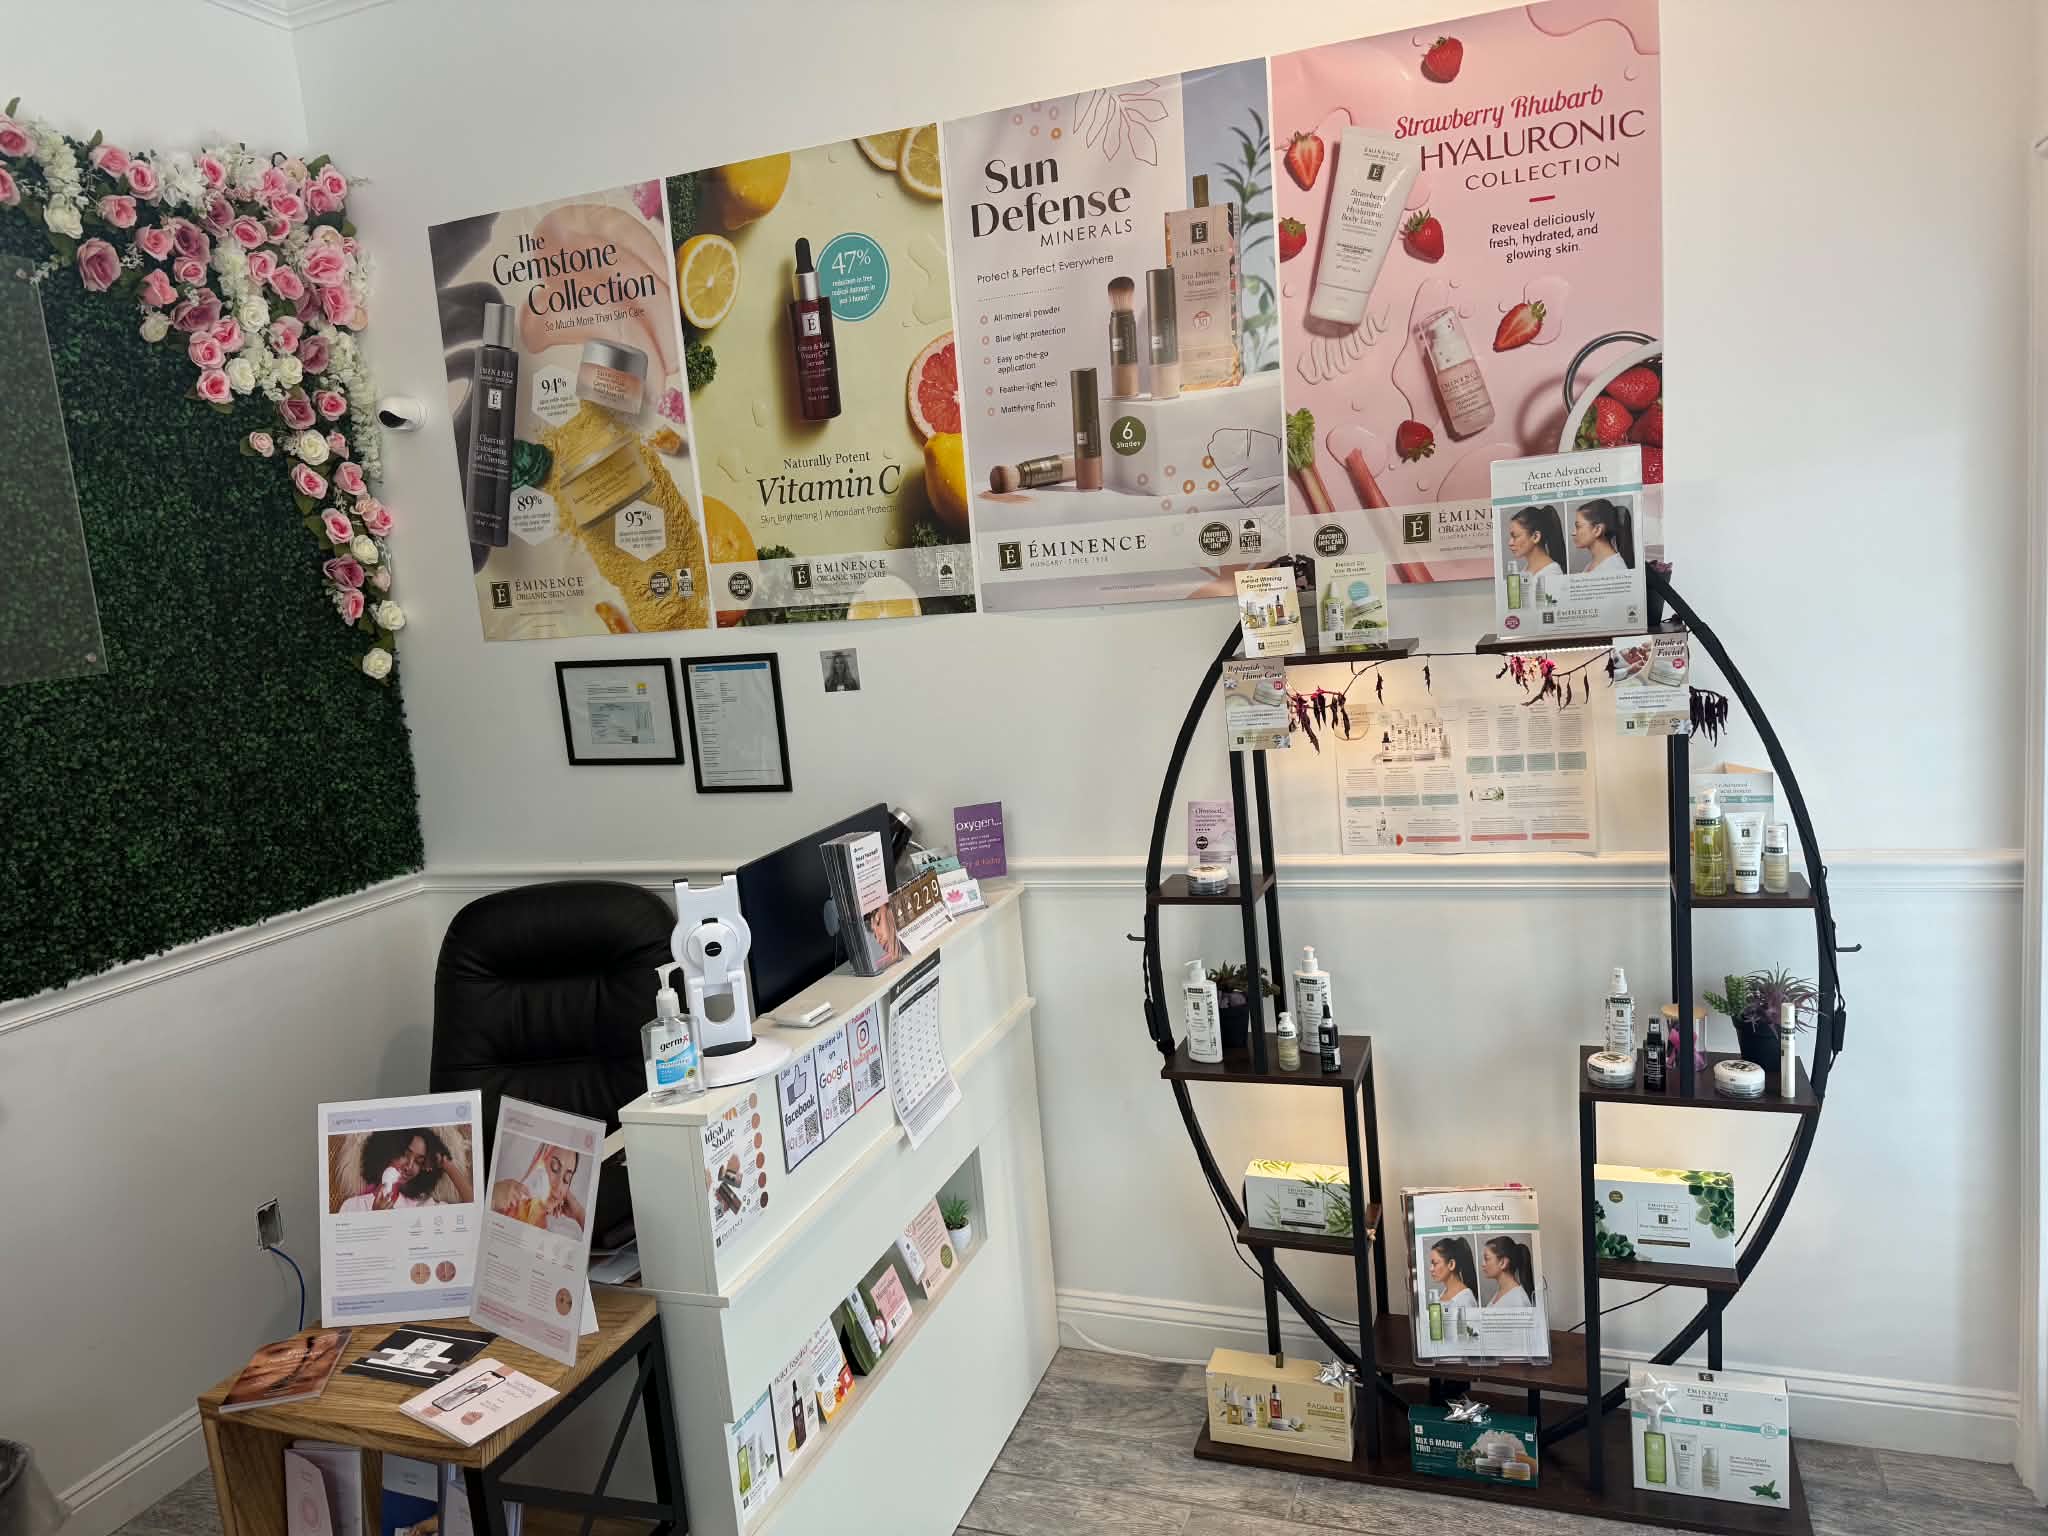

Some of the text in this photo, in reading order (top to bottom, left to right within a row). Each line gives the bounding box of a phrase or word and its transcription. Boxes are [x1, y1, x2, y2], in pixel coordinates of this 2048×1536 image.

[1394, 84, 1603, 139] Strawberry Rhubarb
[1421, 109, 1646, 171] HYALURONIC
[985, 158, 1059, 194] Sun
[1466, 152, 1620, 190] COLLECTION
[971, 186, 1131, 238] Defense
[1492, 209, 1596, 234] Reveal deliciously
[1040, 219, 1133, 247] MINERALS
[1489, 224, 1598, 249] fresh, hydrated, and
[514, 234, 545, 254] The
[1506, 245, 1551, 263] glowing
[493, 243, 618, 286] Gemstone
[831, 248, 871, 276] 47%
[977, 255, 1114, 284] Protect & Perfect Everywhere
[528, 272, 656, 316] Collection
[544, 307, 645, 332] So Much More Than Skin Care
[993, 305, 1060, 323] All-mineral powder
[995, 326, 1066, 343] Blue light protection
[996, 351, 1049, 367] Easy on-the-go
[997, 362, 1036, 374] application
[999, 379, 1057, 394] Feather-light feel
[1000, 399, 1056, 416] Mattifying finish
[1122, 421, 1134, 440] 6
[1116, 440, 1142, 449] Shades
[784, 450, 871, 470] Naturally Potent
[1527, 463, 1601, 481] Acne Advanced
[757, 464, 902, 506] Vitamin C
[1522, 475, 1608, 492] Treatment System
[517, 494, 543, 512] 89%
[760, 514, 775, 525] Skin
[777, 511, 818, 526] Brightening
[824, 506, 866, 519] Antioxidant
[1028, 534, 1147, 559] ÉMINENCE
[816, 558, 887, 574] ÉMINENCE
[515, 575, 585, 593] ÉMINENCE
[819, 1058, 849, 1090] Google
[784, 1094, 816, 1128] facebook
[1444, 1203, 1505, 1214] Acne Advanced
[1482, 1212, 1511, 1223] System
